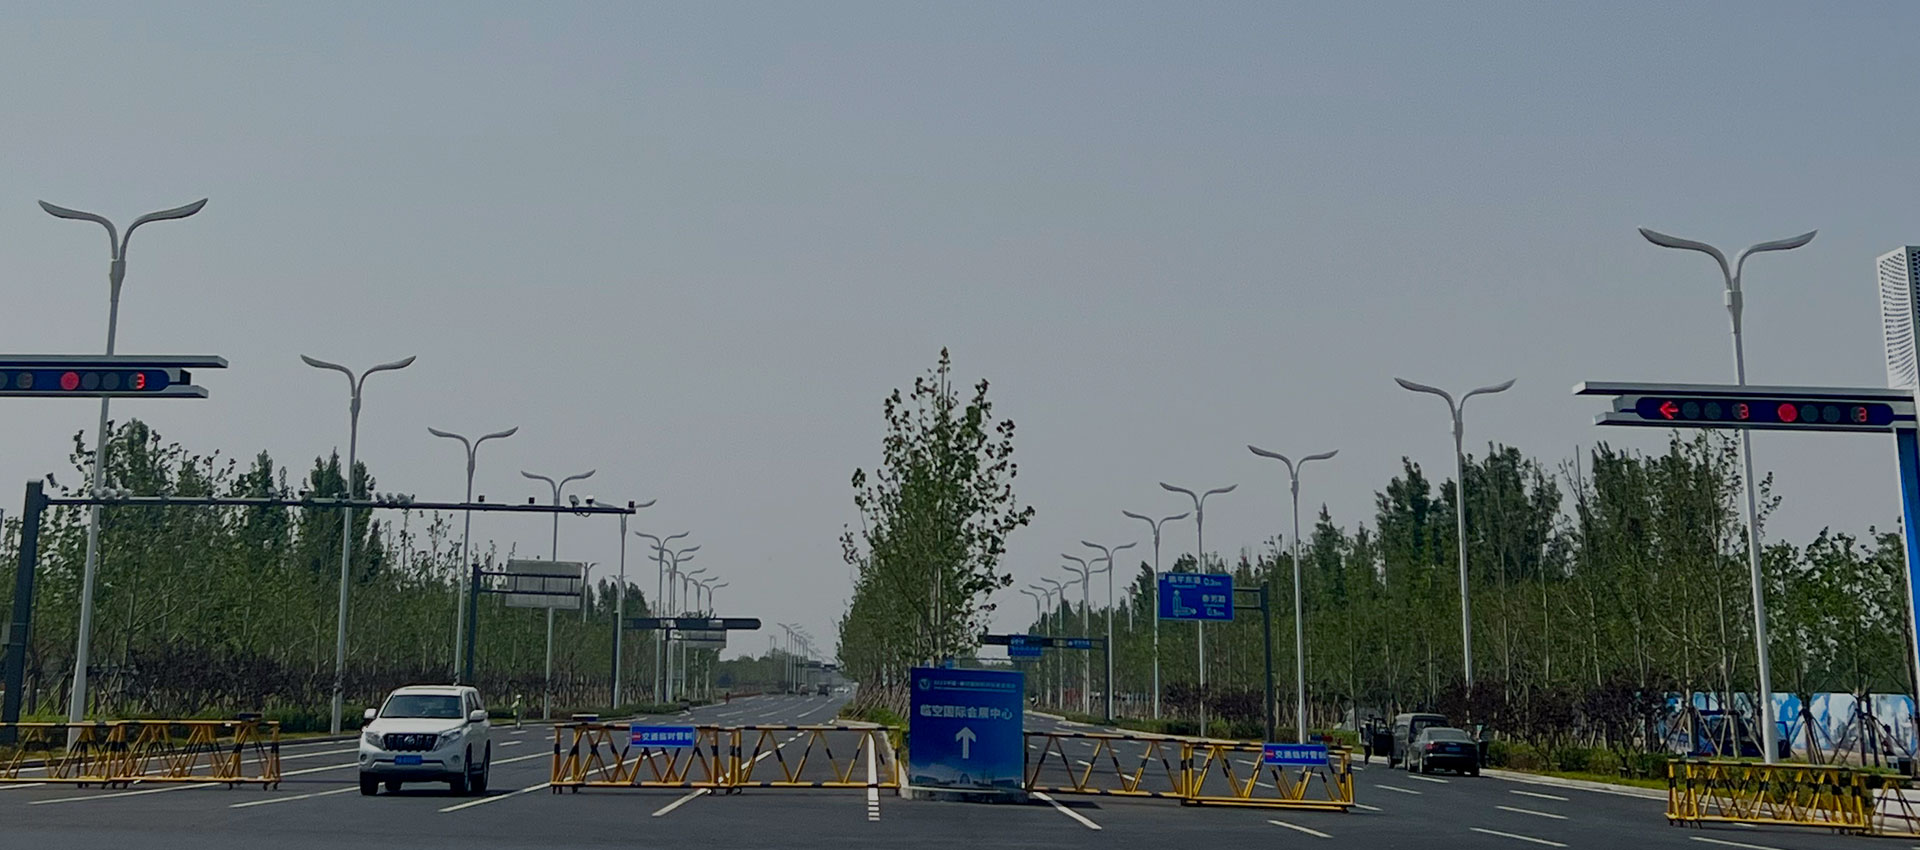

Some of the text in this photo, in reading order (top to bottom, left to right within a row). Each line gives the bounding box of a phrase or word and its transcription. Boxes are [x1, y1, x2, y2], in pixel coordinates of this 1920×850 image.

[136, 373, 145, 389] 3
[1739, 404, 1749, 419] 3
[1858, 407, 1867, 422] 3
[920, 704, 1013, 720] 临空国际会展中心
